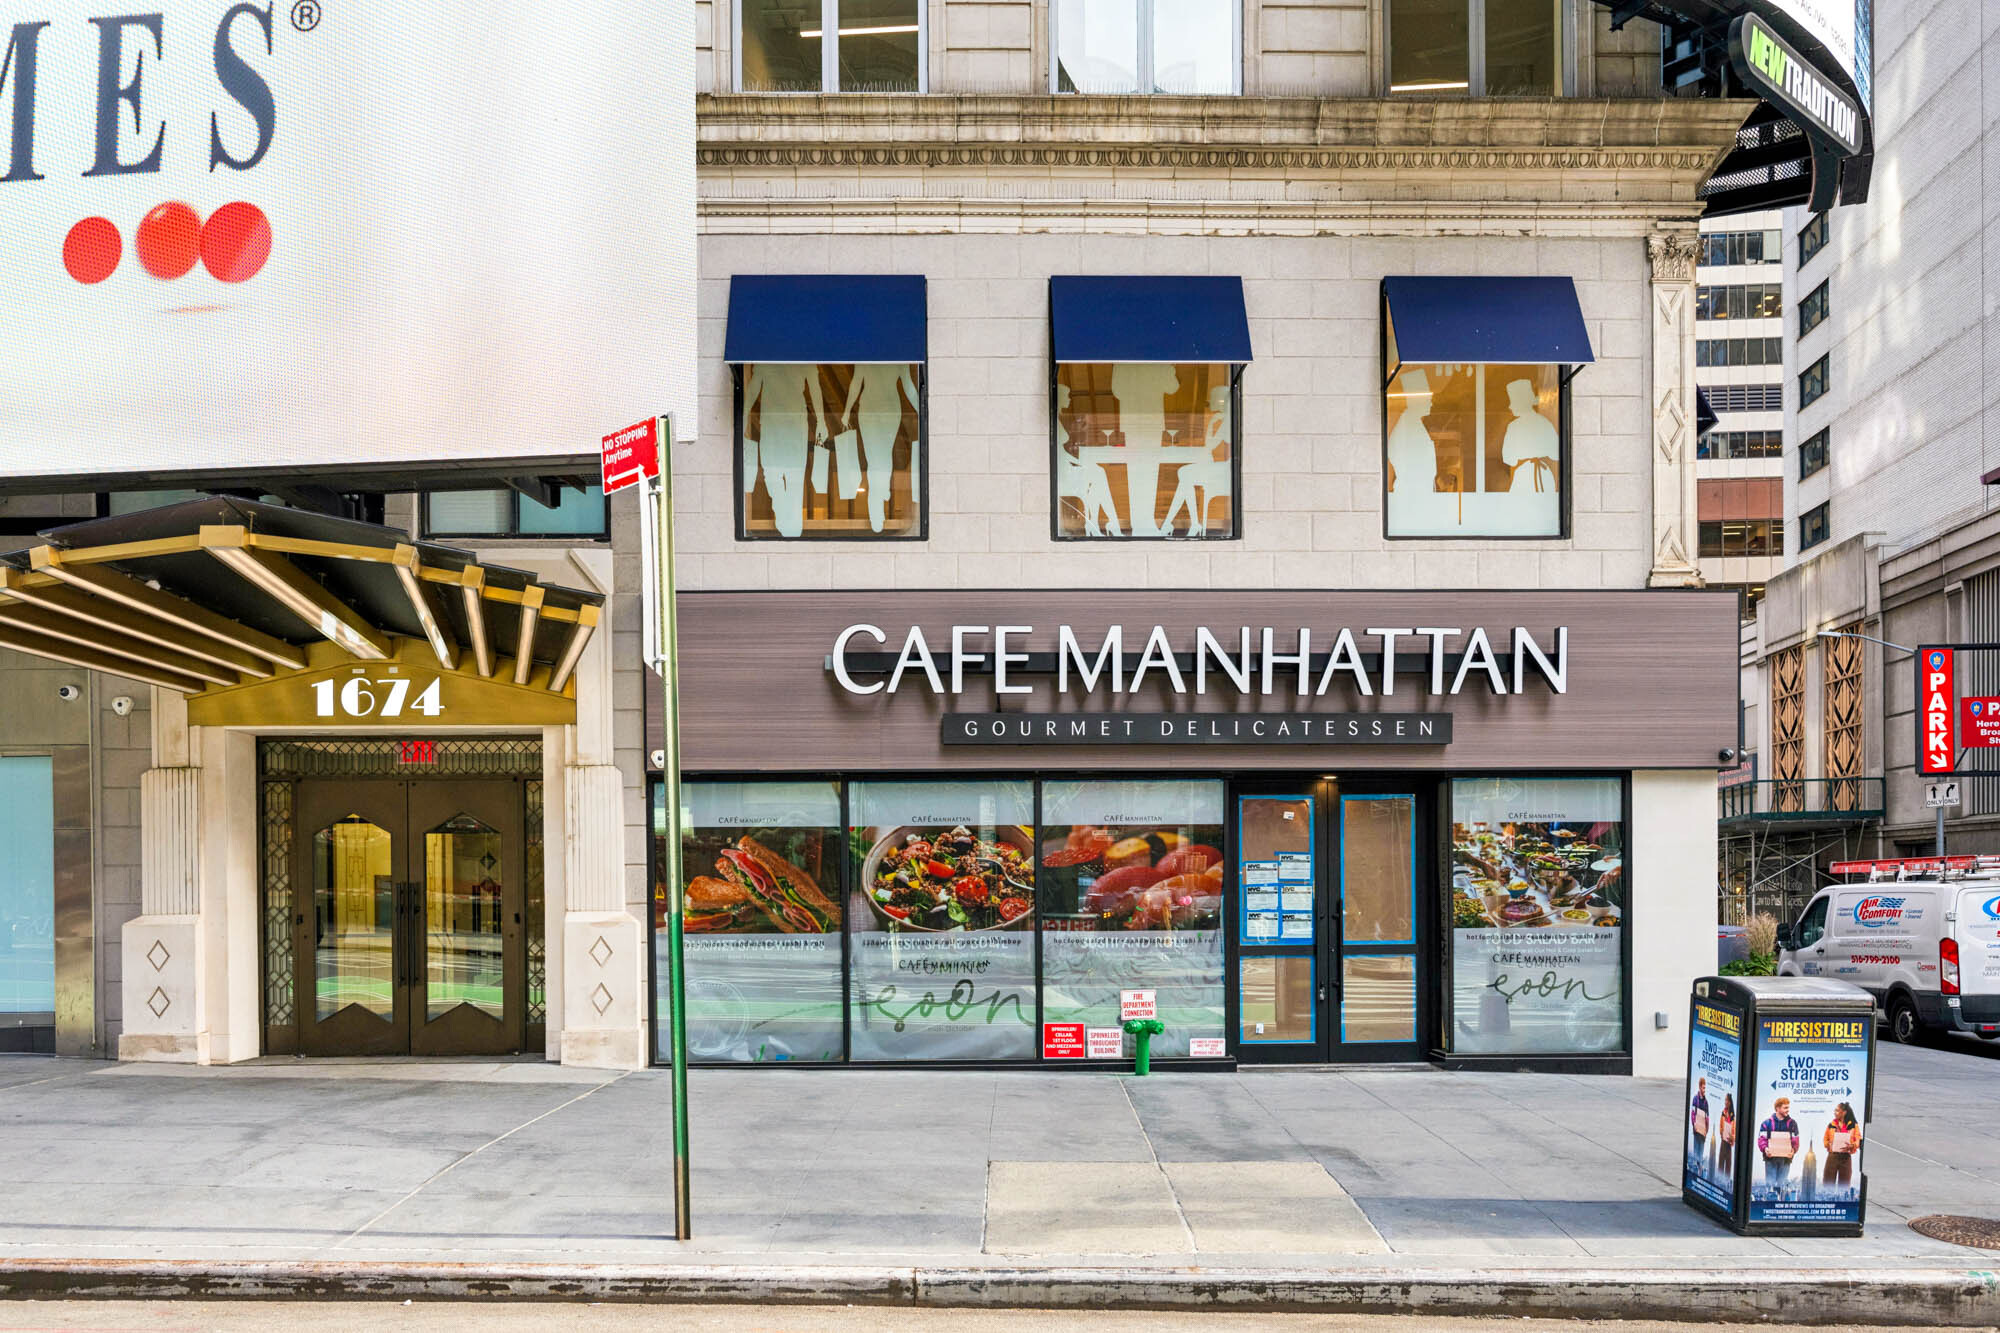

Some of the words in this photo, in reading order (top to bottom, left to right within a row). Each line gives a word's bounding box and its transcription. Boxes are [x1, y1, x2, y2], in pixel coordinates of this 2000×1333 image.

[604, 439, 614, 452] NO
[615, 425, 648, 447] STOPPING
[605, 447, 632, 464] Anytime
[833, 624, 1033, 695] CAFE
[1058, 625, 1568, 696] MANHATTAN
[311, 677, 446, 716] 1674
[1928, 673, 1948, 751] PARK
[1988, 702, 2000, 715] P
[965, 720, 1133, 737] GOURMET
[1161, 720, 1434, 737] DELICATESSEN
[1859, 898, 1879, 916] AIR
[1861, 908, 1903, 920] COMFORT
[1492, 952, 1522, 963] CAFÉ
[1524, 955, 1581, 963] MANHATTAN
[1851, 955, 1900, 965] 516-799-2100
[1123, 1001, 1154, 1009] DEPARTMENT
[1704, 1038, 1718, 1053] two
[1701, 1050, 1733, 1073] strangers
[1787, 1054, 1814, 1068] two
[1780, 1067, 1849, 1084] strangers
[1778, 1081, 1794, 1090] carry
[1801, 1080, 1817, 1088] cake
[1830, 1087, 1845, 1096] york
